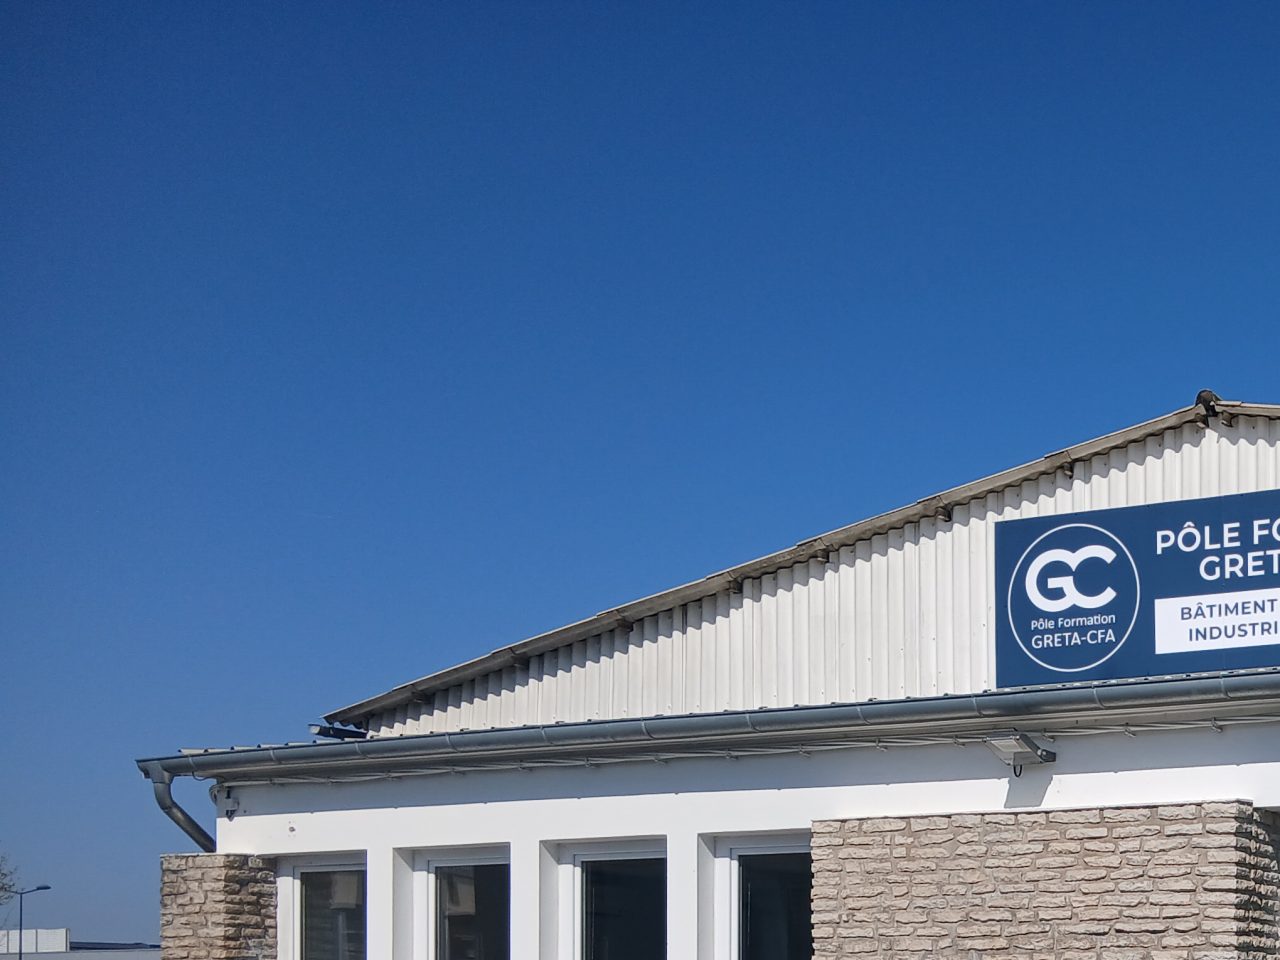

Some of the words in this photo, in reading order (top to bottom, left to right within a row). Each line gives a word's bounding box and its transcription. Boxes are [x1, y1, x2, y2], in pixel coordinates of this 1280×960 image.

[1156, 522, 1241, 555] PÔLE
[1025, 545, 1117, 612] GC
[1180, 598, 1278, 621] BÂTIMENT
[1031, 618, 1055, 631] Pôle
[1058, 613, 1116, 628] Formation
[1031, 629, 1116, 649] GRETA-CFA
